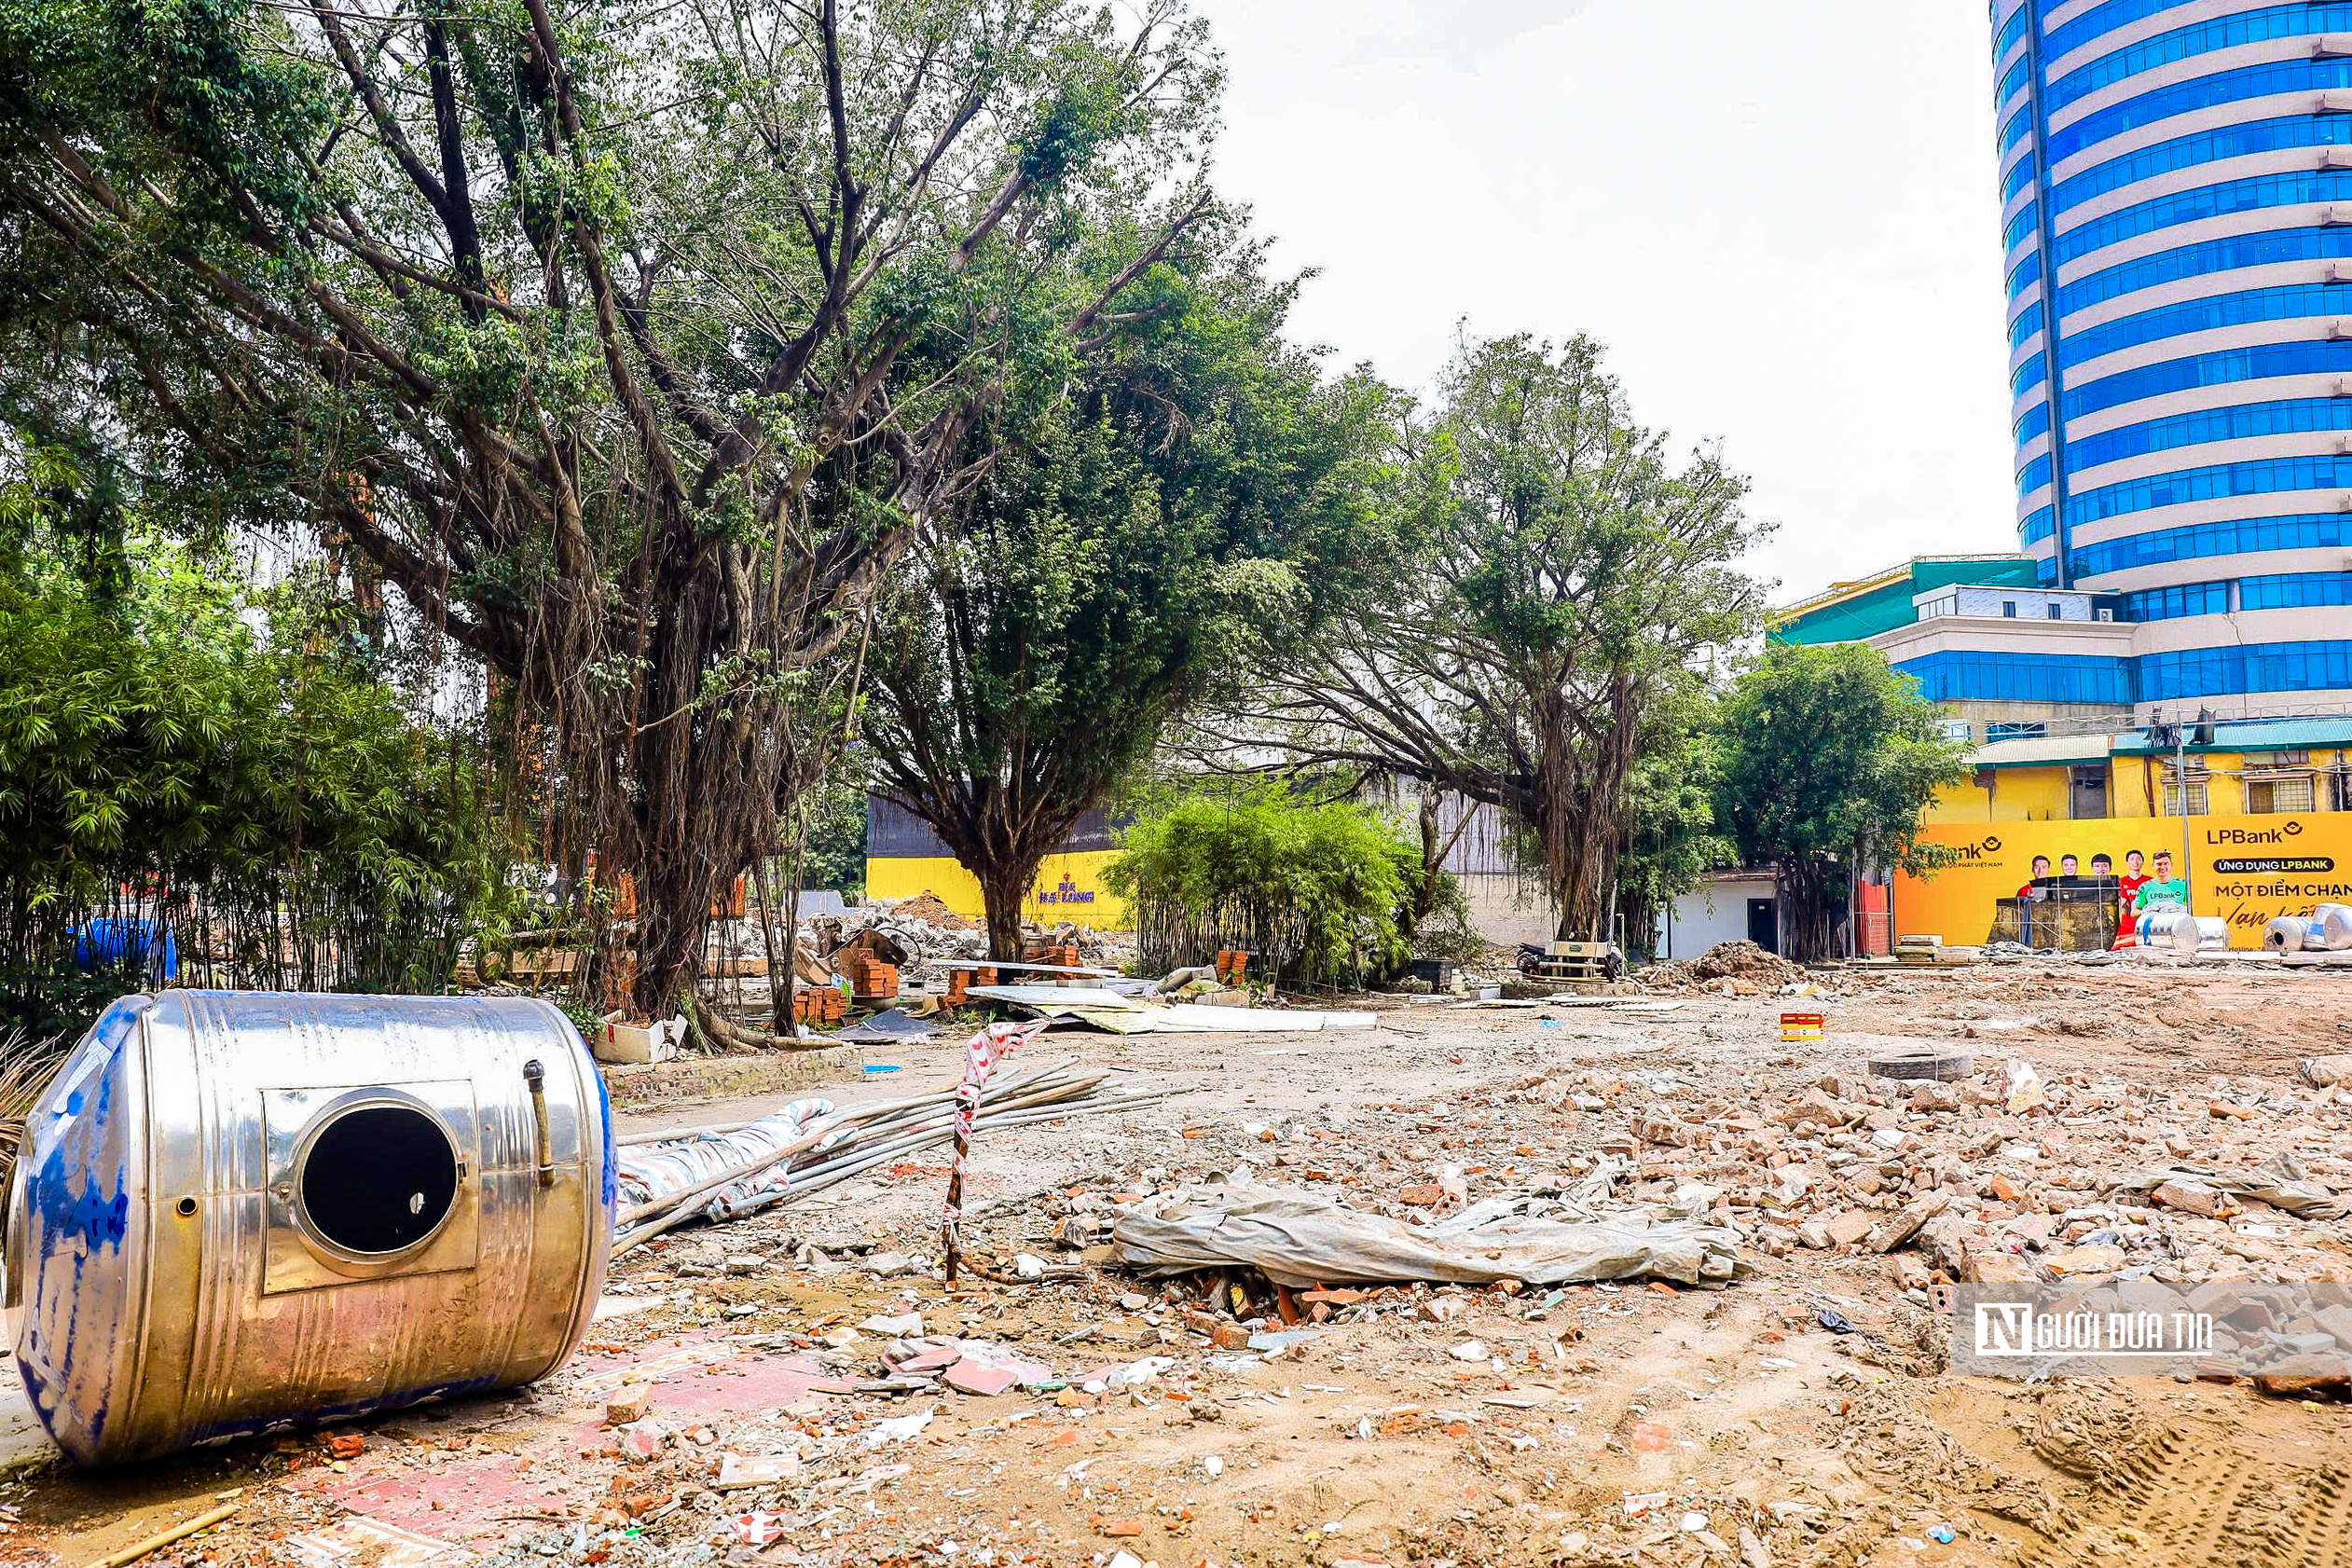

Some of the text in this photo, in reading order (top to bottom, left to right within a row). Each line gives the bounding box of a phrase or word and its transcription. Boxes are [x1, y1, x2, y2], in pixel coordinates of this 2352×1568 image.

[2207, 828, 2283, 845] LPBank
[2218, 859, 2329, 873] ỨNG DỤNG LPBANK
[1061, 890, 1094, 903] LONG
[2215, 881, 2254, 901] MỘT
[2256, 878, 2301, 897] ĐIỂM
